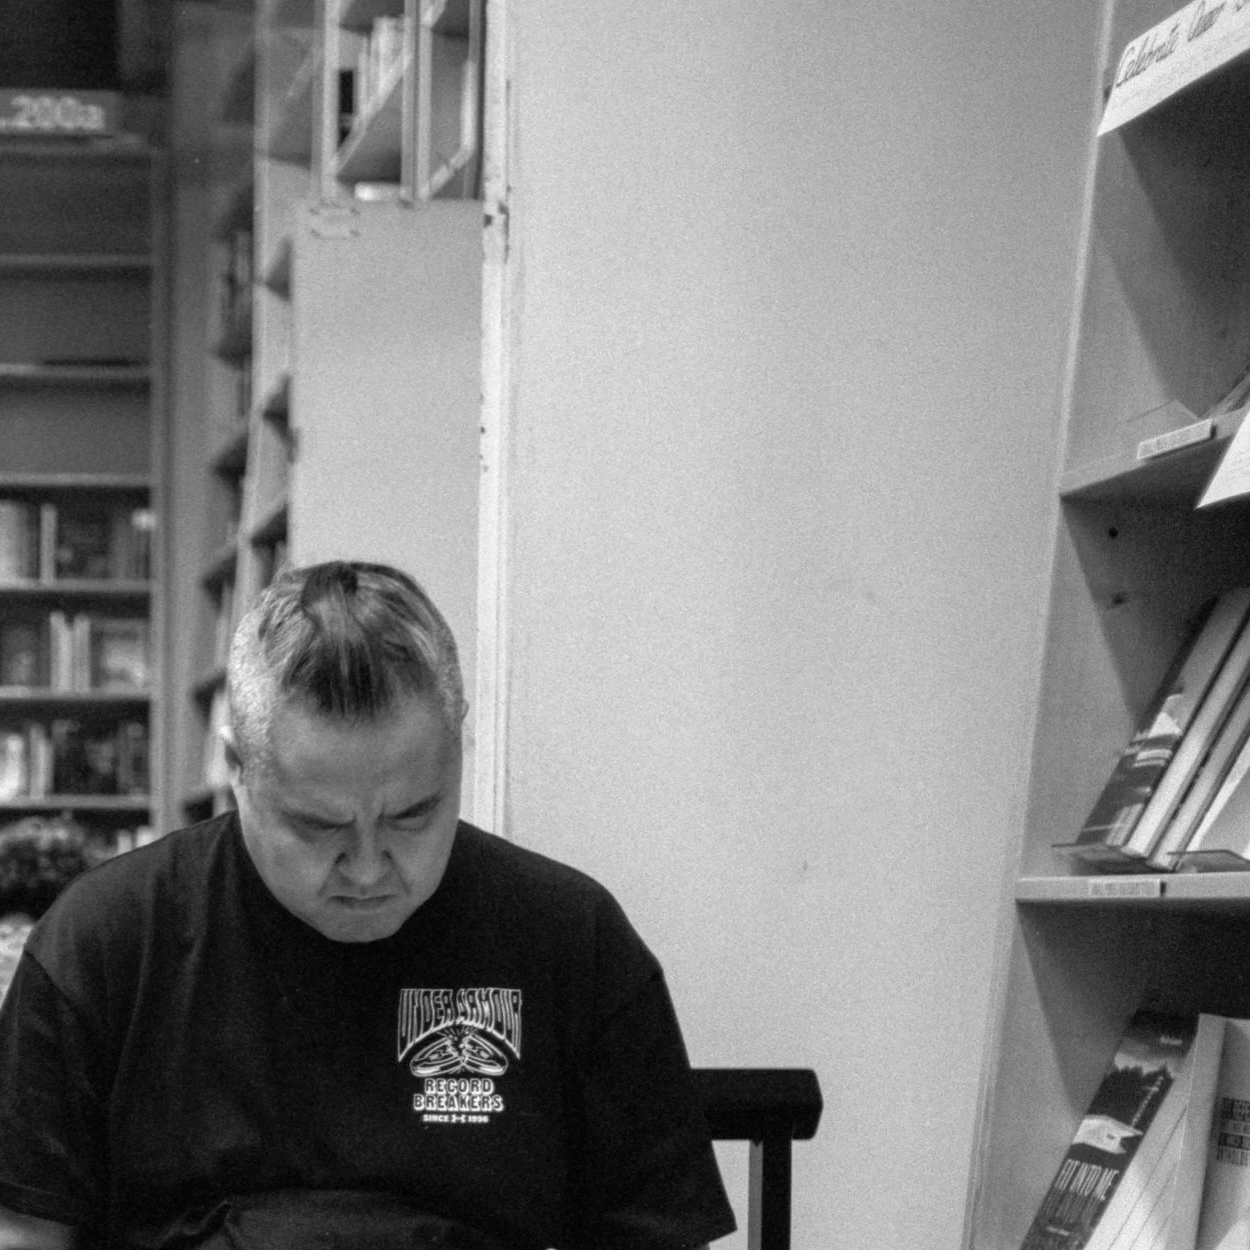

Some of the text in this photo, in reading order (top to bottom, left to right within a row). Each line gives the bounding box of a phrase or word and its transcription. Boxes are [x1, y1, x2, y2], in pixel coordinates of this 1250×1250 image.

[424, 1078, 495, 1095] RECORD
[413, 1093, 504, 1112] BREAKERS
[423, 1114, 449, 1123] SINCE
